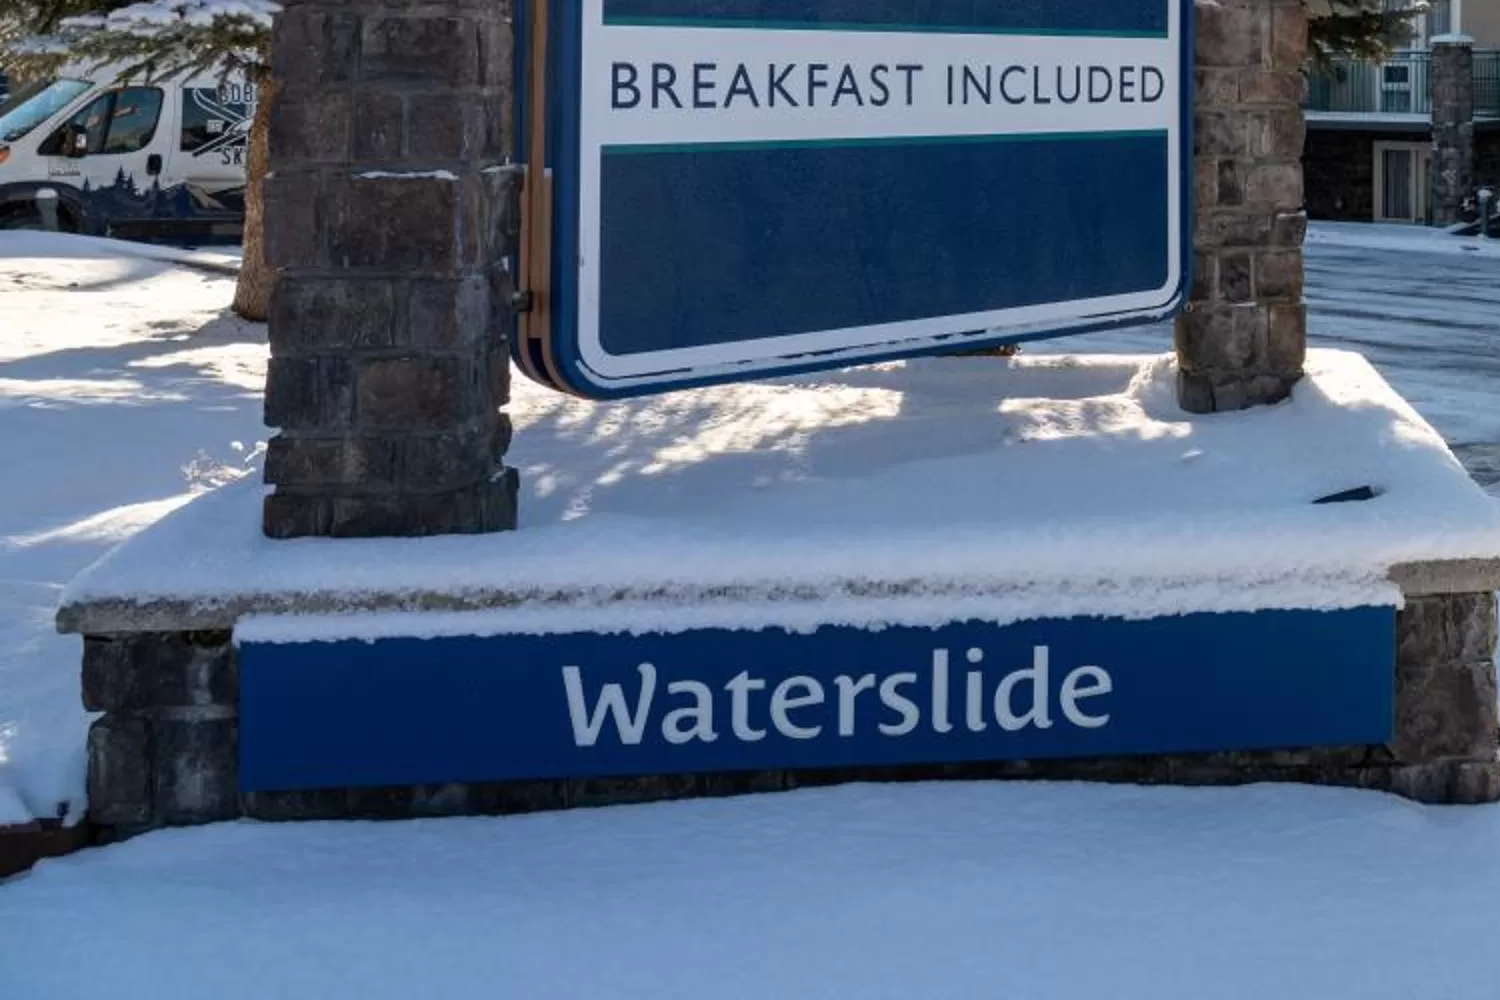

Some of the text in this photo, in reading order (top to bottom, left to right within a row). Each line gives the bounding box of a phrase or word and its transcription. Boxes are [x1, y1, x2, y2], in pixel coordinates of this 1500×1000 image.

[610, 61, 1165, 110] BREAKFAST INCLUDED
[562, 645, 1113, 747] Waterslide
